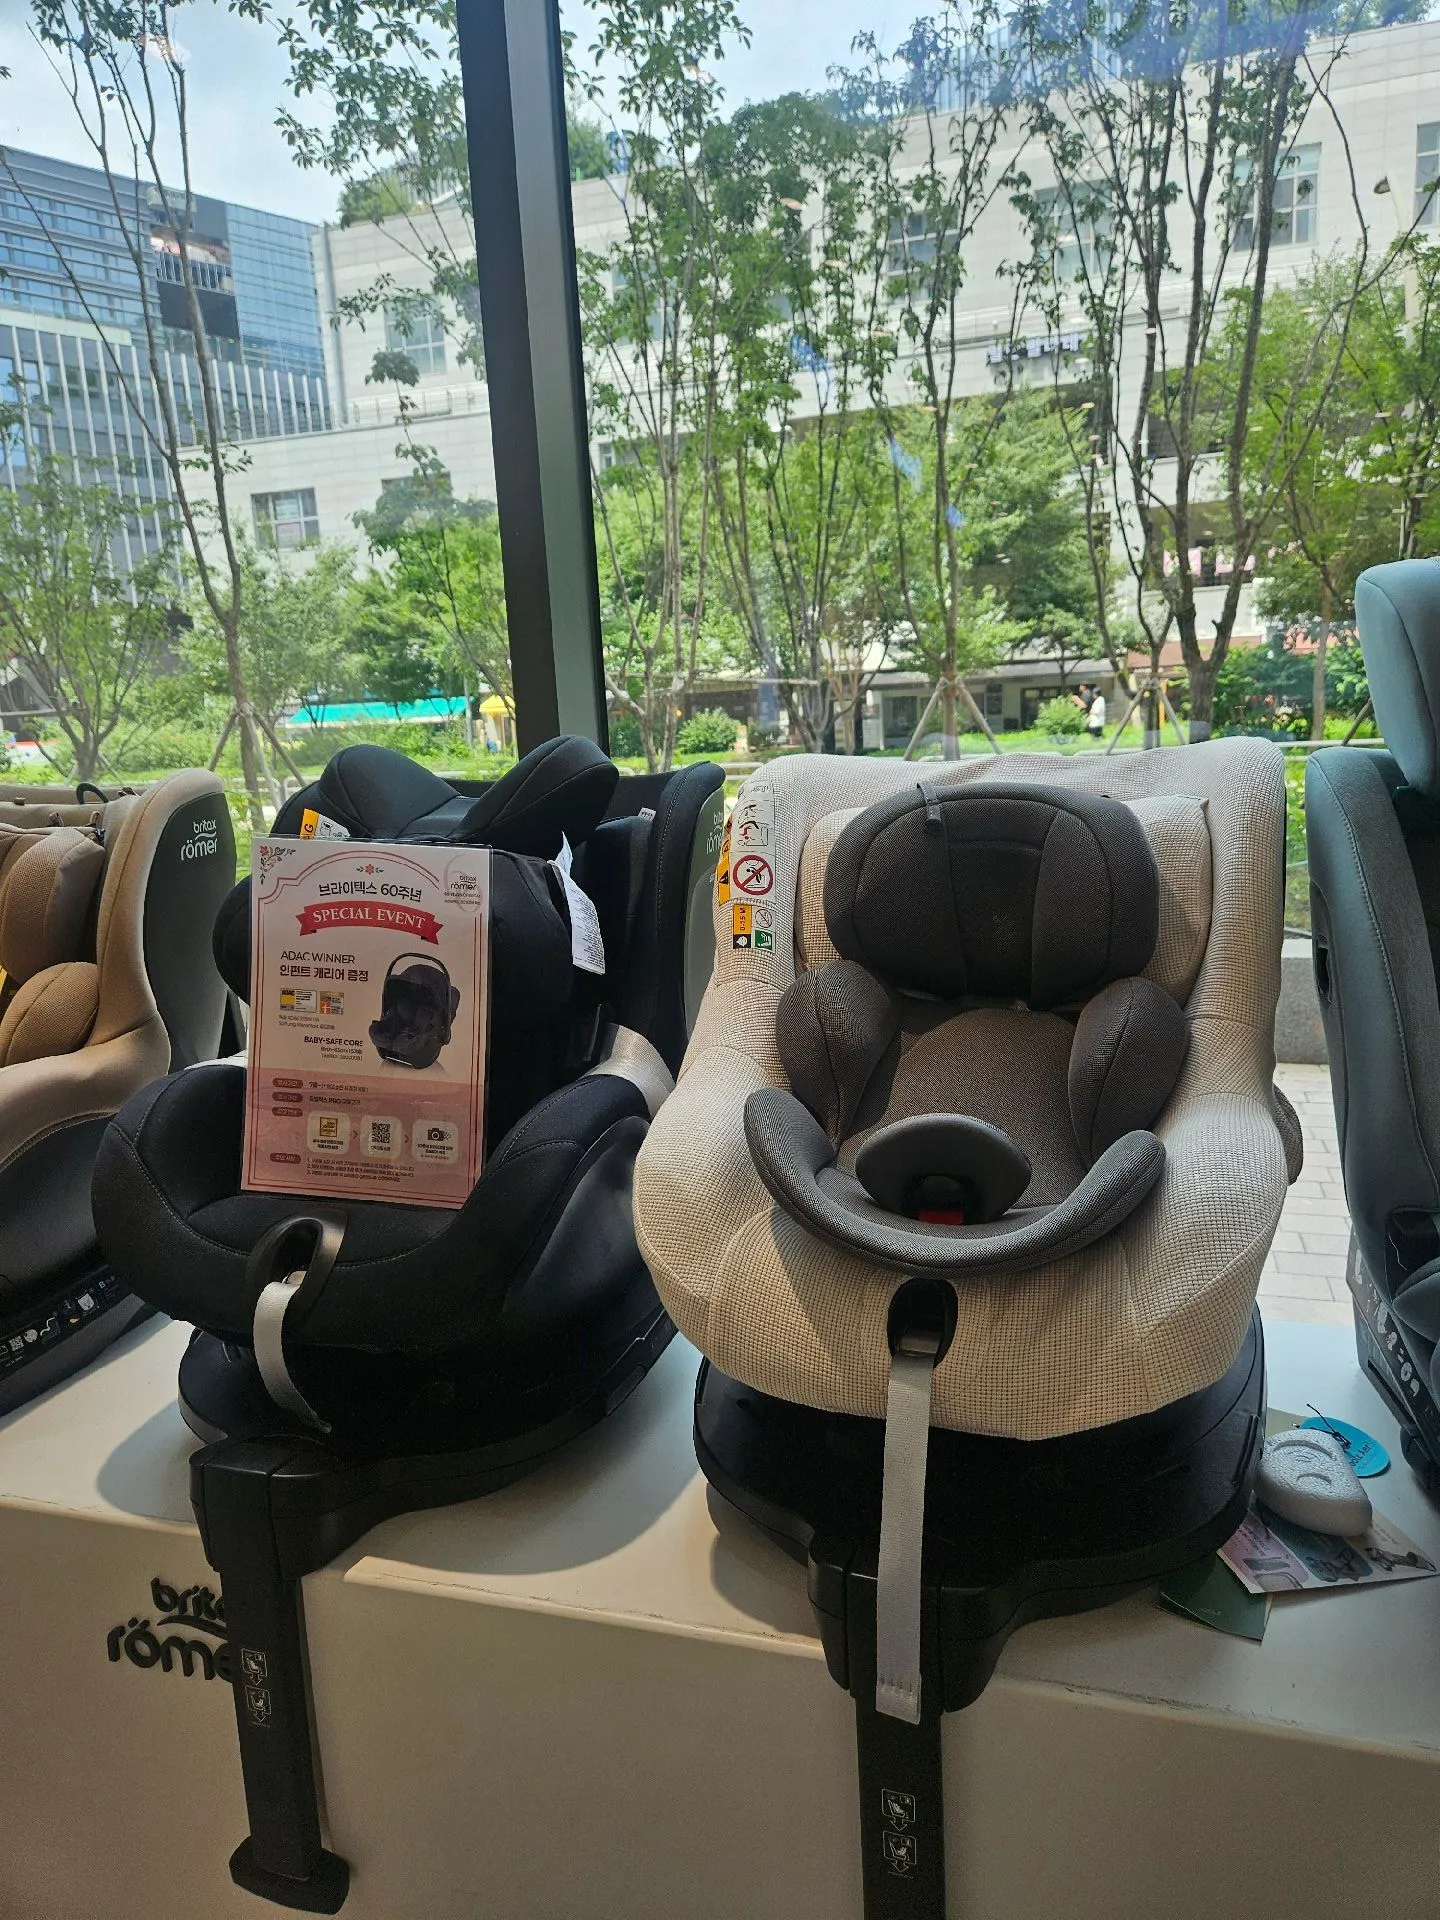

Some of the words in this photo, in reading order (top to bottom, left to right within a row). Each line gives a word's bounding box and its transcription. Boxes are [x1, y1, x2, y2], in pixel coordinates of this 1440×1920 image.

[193, 819, 217, 834] britax
[180, 838, 218, 861] römer
[318, 881, 378, 897] 브라이텍스
[380, 883, 422, 902] 60주년
[450, 881, 477, 891] römer
[312, 907, 373, 923] SPECIAL
[376, 908, 426, 929] EVENT
[280, 950, 311, 961] ADAC
[311, 952, 356, 964] WINNER
[279, 964, 311, 977] 인펀트
[313, 967, 345, 980] 캐리어
[347, 969, 369, 982] 증정
[304, 1036, 343, 1045] BABY-SAFE
[343, 1039, 364, 1047] CORE
[151, 1576, 225, 1621] brit
[106, 1616, 234, 1684] röme
